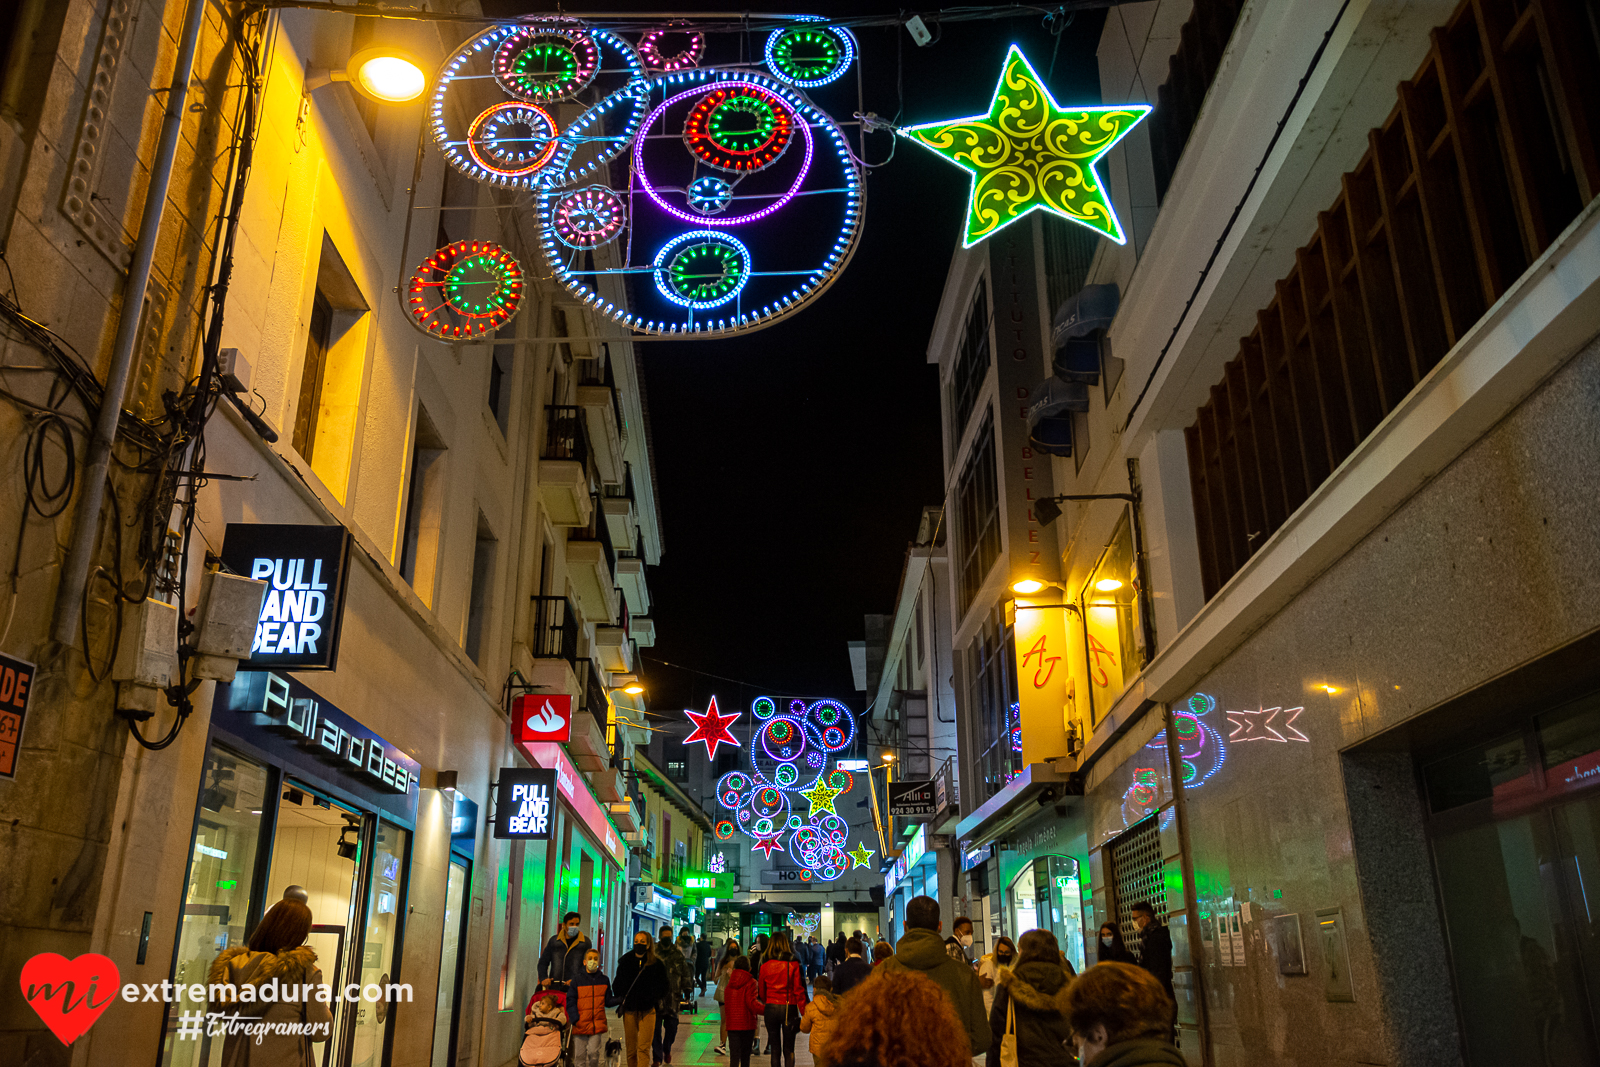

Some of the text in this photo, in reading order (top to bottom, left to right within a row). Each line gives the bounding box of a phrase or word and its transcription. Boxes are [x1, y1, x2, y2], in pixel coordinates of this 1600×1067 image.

[1006, 226, 1028, 362] STITUTO
[251, 557, 328, 591] PULL
[259, 589, 326, 623] AND
[0, 664, 30, 708] DE
[262, 671, 319, 740] Pull
[367, 738, 418, 795] Bear
[511, 784, 550, 802] PULL
[517, 800, 549, 818] AND
[890, 807, 904, 815] 924
[915, 806, 924, 814] 91
[926, 805, 936, 813] 95
[508, 816, 548, 834] BEAR
